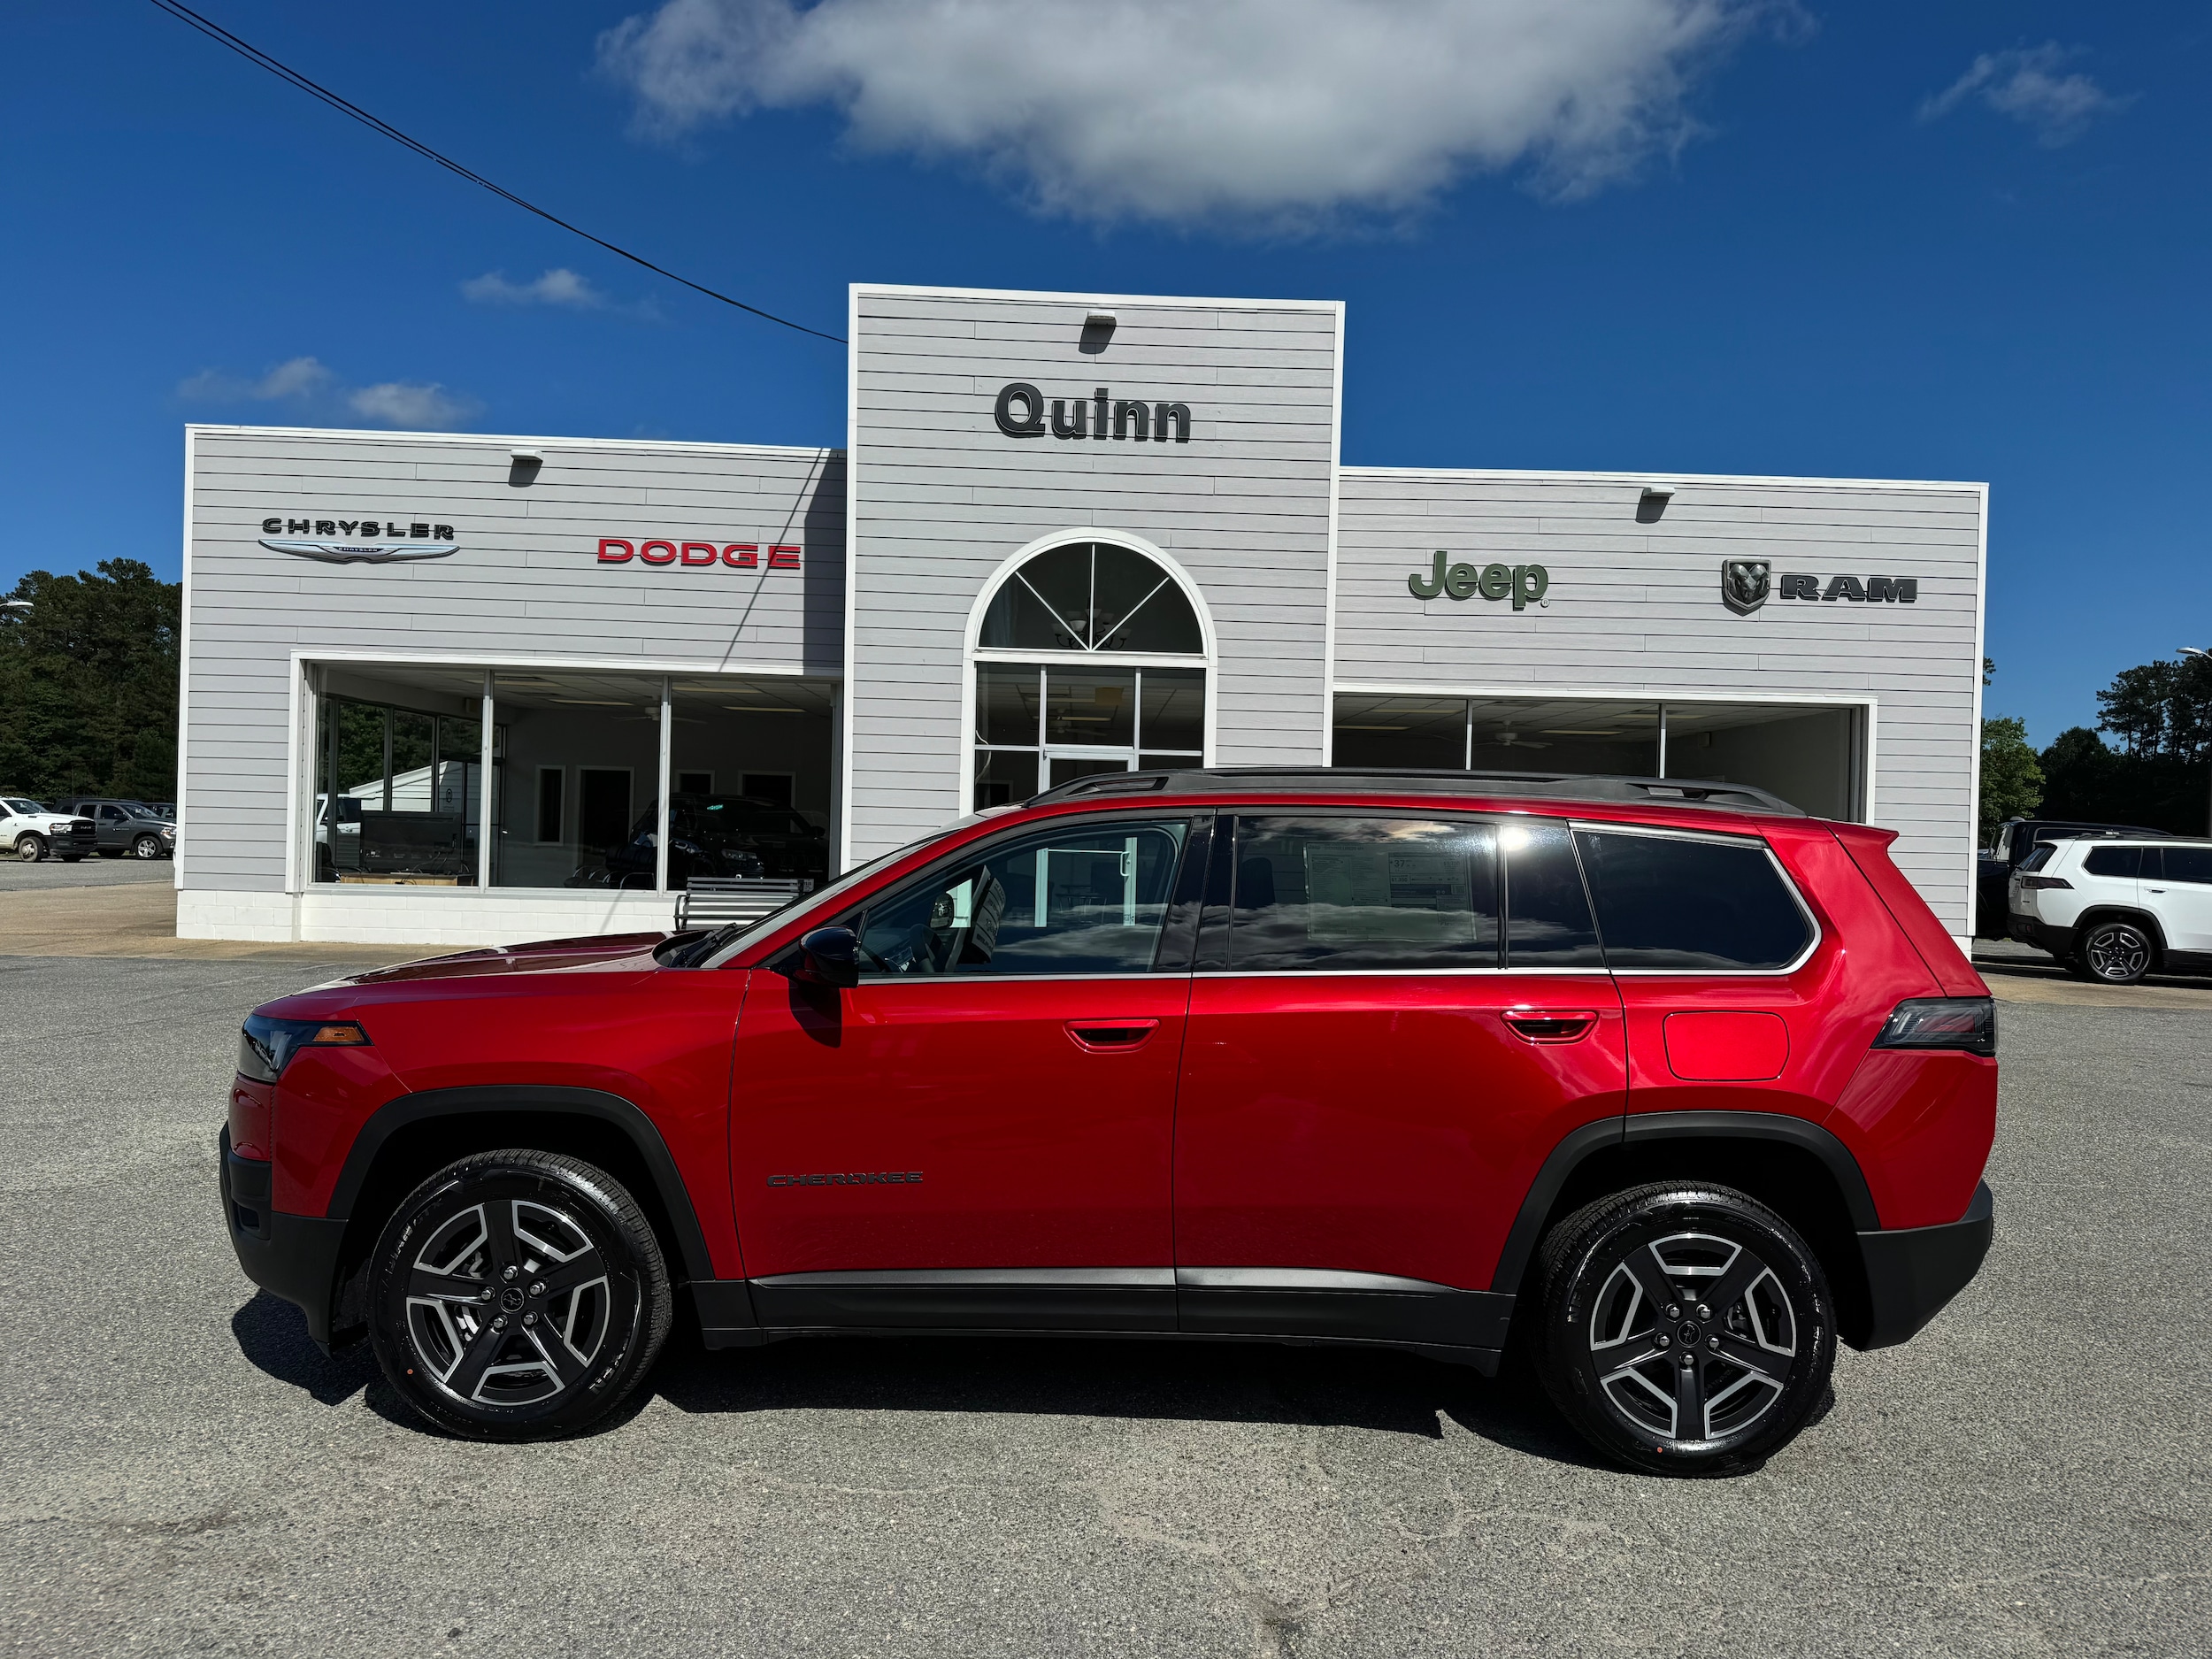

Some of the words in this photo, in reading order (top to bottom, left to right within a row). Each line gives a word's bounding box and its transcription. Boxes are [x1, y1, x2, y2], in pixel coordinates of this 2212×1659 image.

[995, 382, 1191, 442] Quinn
[262, 518, 455, 541] CHRYSLER
[597, 538, 802, 569] DODGE
[1780, 574, 1918, 603] RAM
[766, 1171, 924, 1187] CHEROKEE
